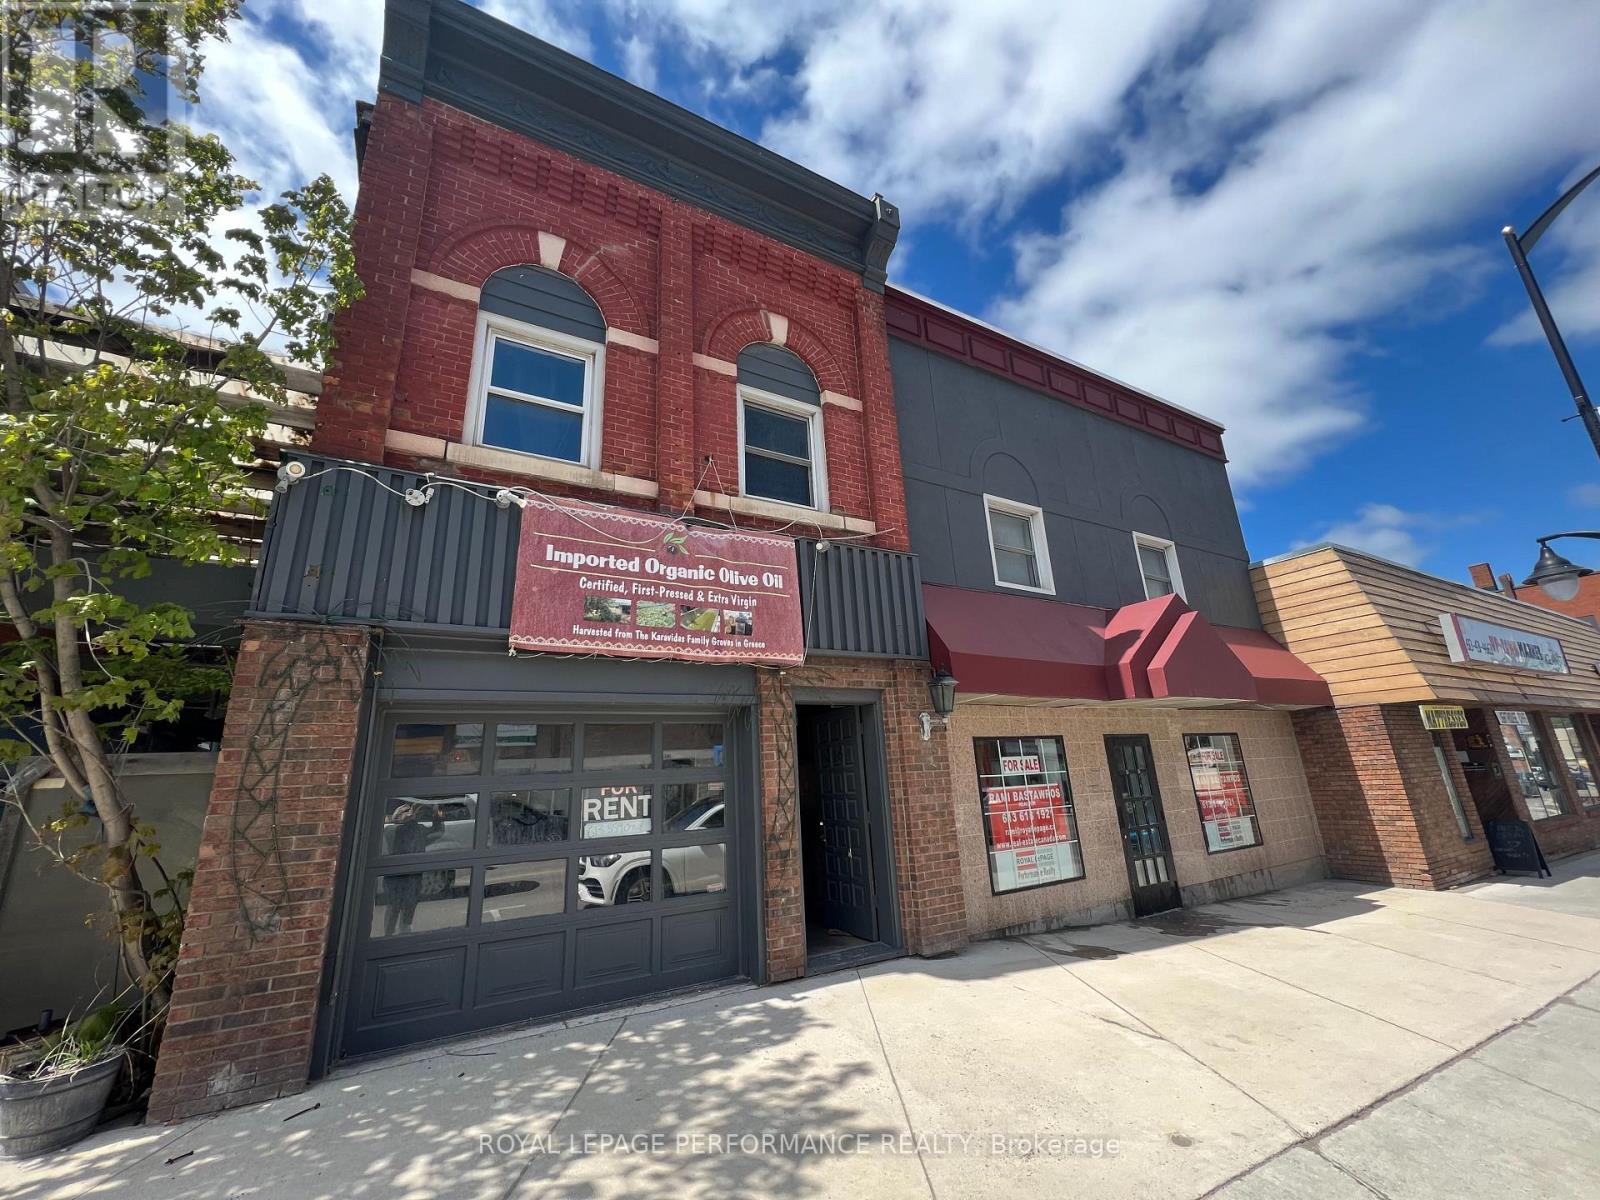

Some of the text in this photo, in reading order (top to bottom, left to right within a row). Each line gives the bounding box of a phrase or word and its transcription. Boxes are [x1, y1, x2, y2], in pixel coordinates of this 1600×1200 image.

[546, 544, 783, 589] Imported Organic Olive Oil
[579, 576, 757, 609] Certified, First-Pressed & Extra Virgin
[573, 625, 613, 637] Harvested
[615, 628, 633, 638] from
[636, 630, 649, 640] The
[687, 635, 709, 647] Family
[711, 637, 734, 648] Groves
[736, 639, 742, 648] in
[743, 640, 766, 649] Greece
[1003, 759, 1040, 772] FOR SALE
[1012, 788, 1061, 802] BASTAWROS
[583, 795, 652, 821] RENT
